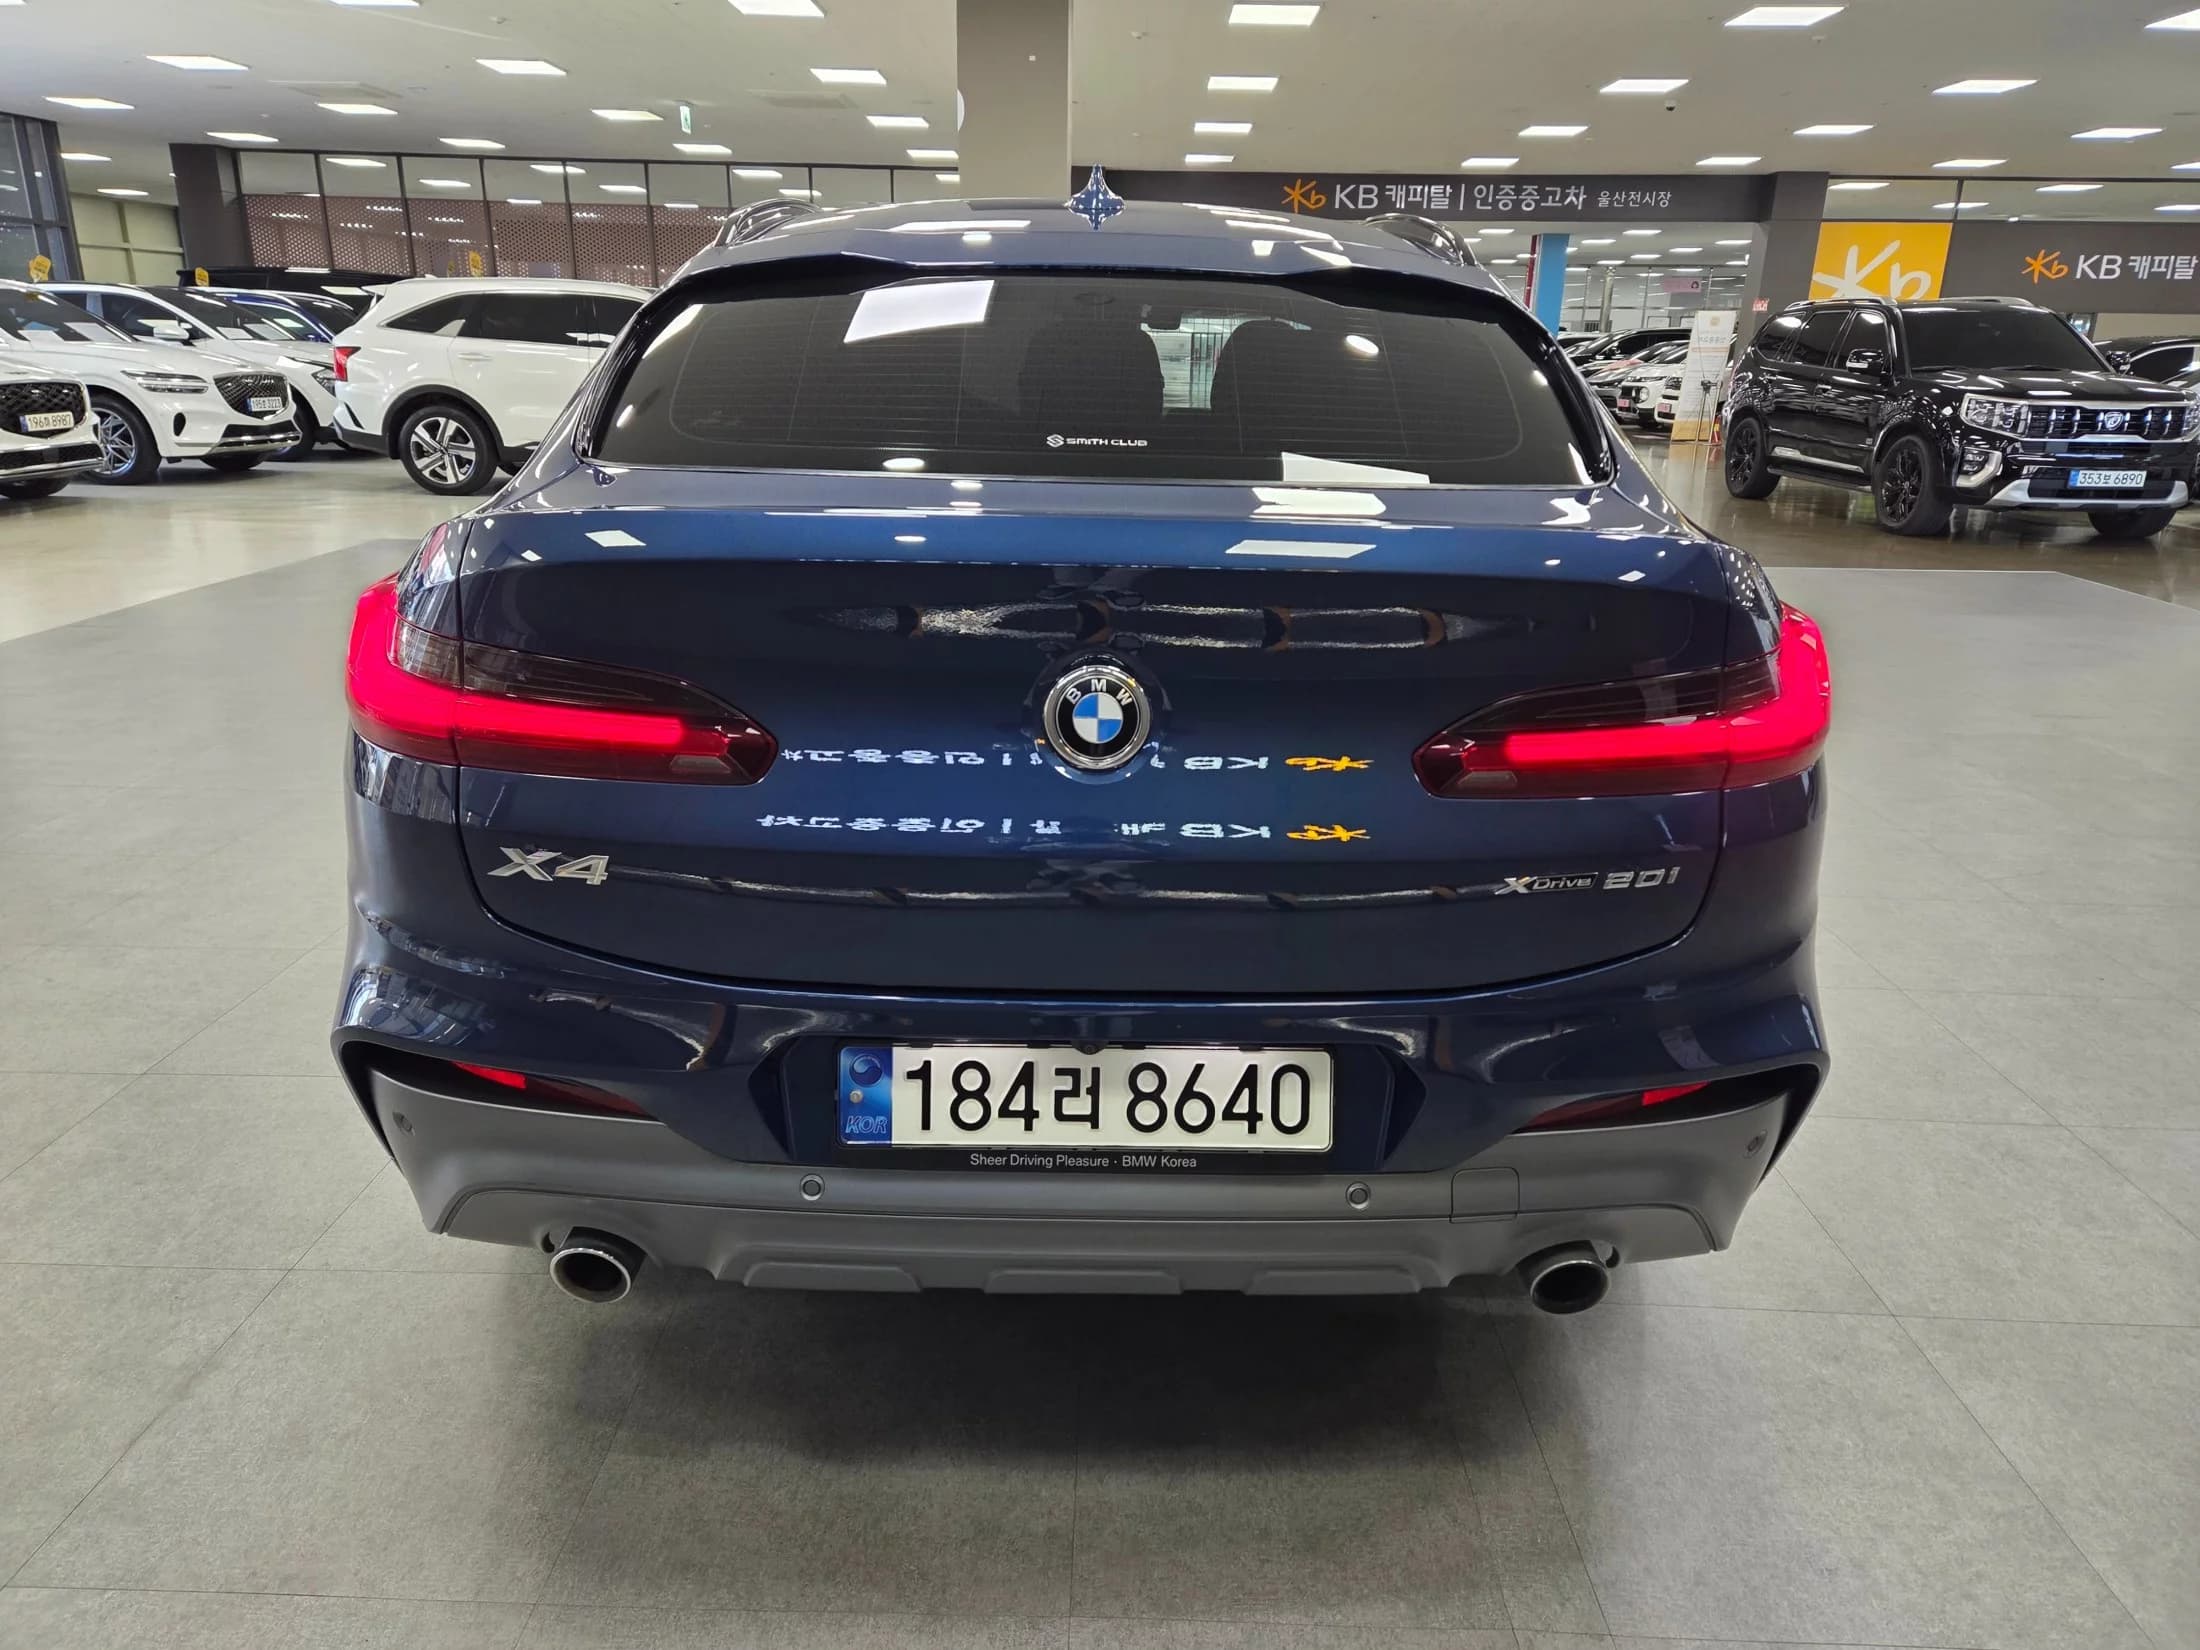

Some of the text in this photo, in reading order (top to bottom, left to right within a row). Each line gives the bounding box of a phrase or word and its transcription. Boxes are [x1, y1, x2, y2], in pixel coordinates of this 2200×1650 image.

[1334, 184, 1379, 209] KB
[1385, 184, 1453, 210] 캐피탈
[1473, 184, 1588, 211] 인증중고차
[1597, 190, 1672, 208] 울산전시장
[2075, 254, 2123, 280] KB
[2128, 255, 2199, 280] 캐피탈
[1065, 438, 1148, 447] SMITH CLUB
[2113, 473, 2144, 486] 6890
[1066, 679, 1133, 706] BMW
[487, 846, 609, 886] X4
[906, 1059, 1311, 1134] 184러 8640
[845, 1115, 888, 1134] KOR
[970, 1153, 1197, 1169] Sheer Driving Pleasure BMW Korea
